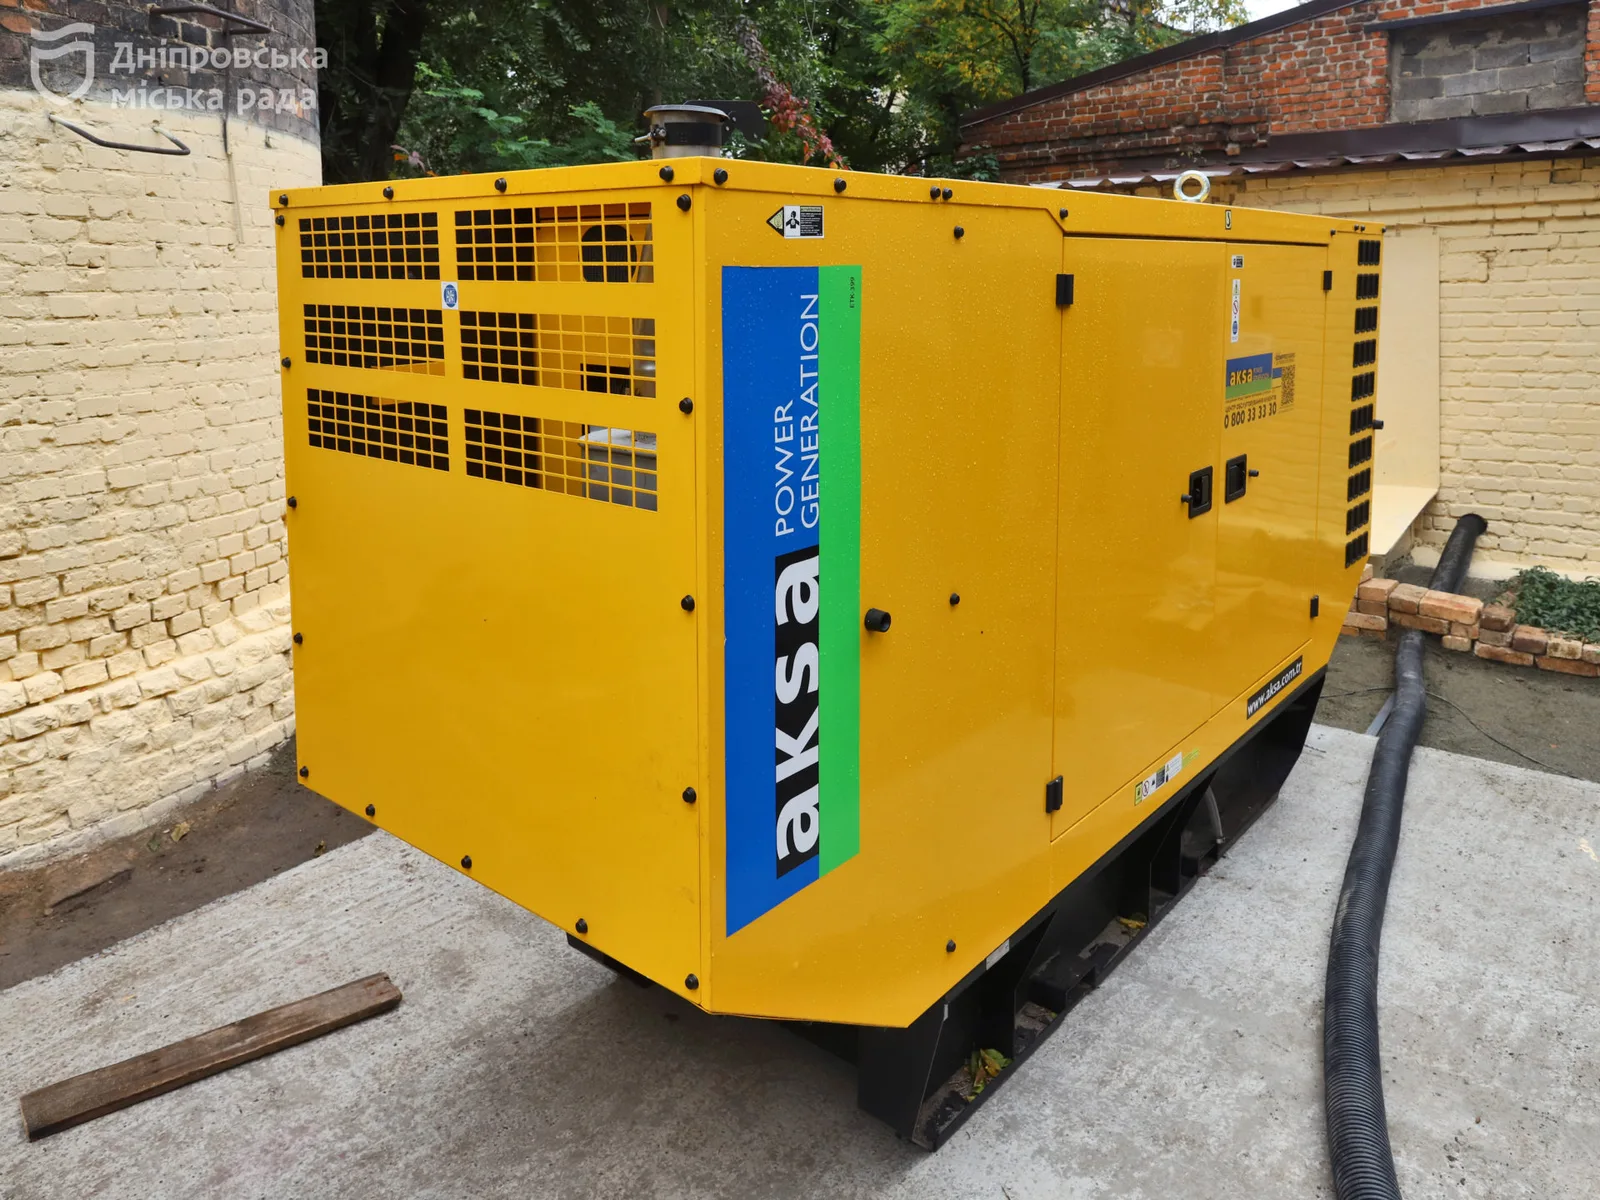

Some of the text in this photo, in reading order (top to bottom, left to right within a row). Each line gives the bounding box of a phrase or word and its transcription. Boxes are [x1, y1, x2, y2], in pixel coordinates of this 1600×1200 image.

[800, 294, 820, 529] GENERATION
[1224, 414, 1229, 429] 0
[1231, 410, 1246, 427] 800
[1247, 407, 1256, 422] 33
[1258, 404, 1267, 419] 33
[1268, 402, 1277, 416] 30
[1229, 368, 1254, 386] aksa
[774, 400, 795, 537] POWER
[775, 555, 820, 861] aksa
[1247, 662, 1302, 716] www.aksa.com.tr
